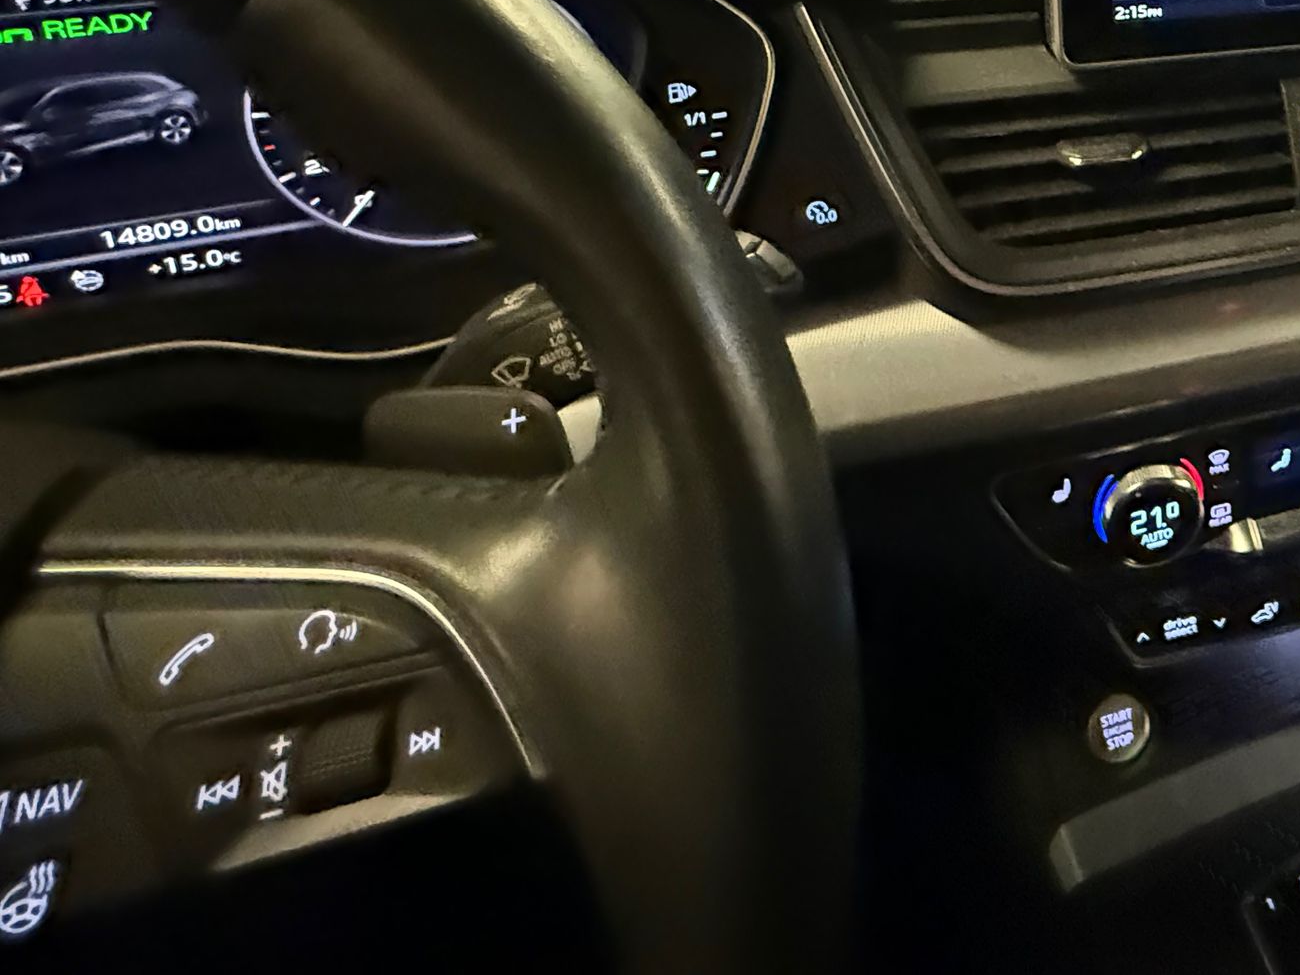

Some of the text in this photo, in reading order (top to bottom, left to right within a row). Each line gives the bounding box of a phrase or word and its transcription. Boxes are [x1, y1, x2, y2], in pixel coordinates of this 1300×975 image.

[42, 11, 153, 40] READY
[683, 111, 706, 126] 1/1
[1140, 527, 1174, 546] AUTO
[1100, 707, 1133, 729] START
[1106, 731, 1135, 751] STOP
[14, 778, 84, 824] NAV
